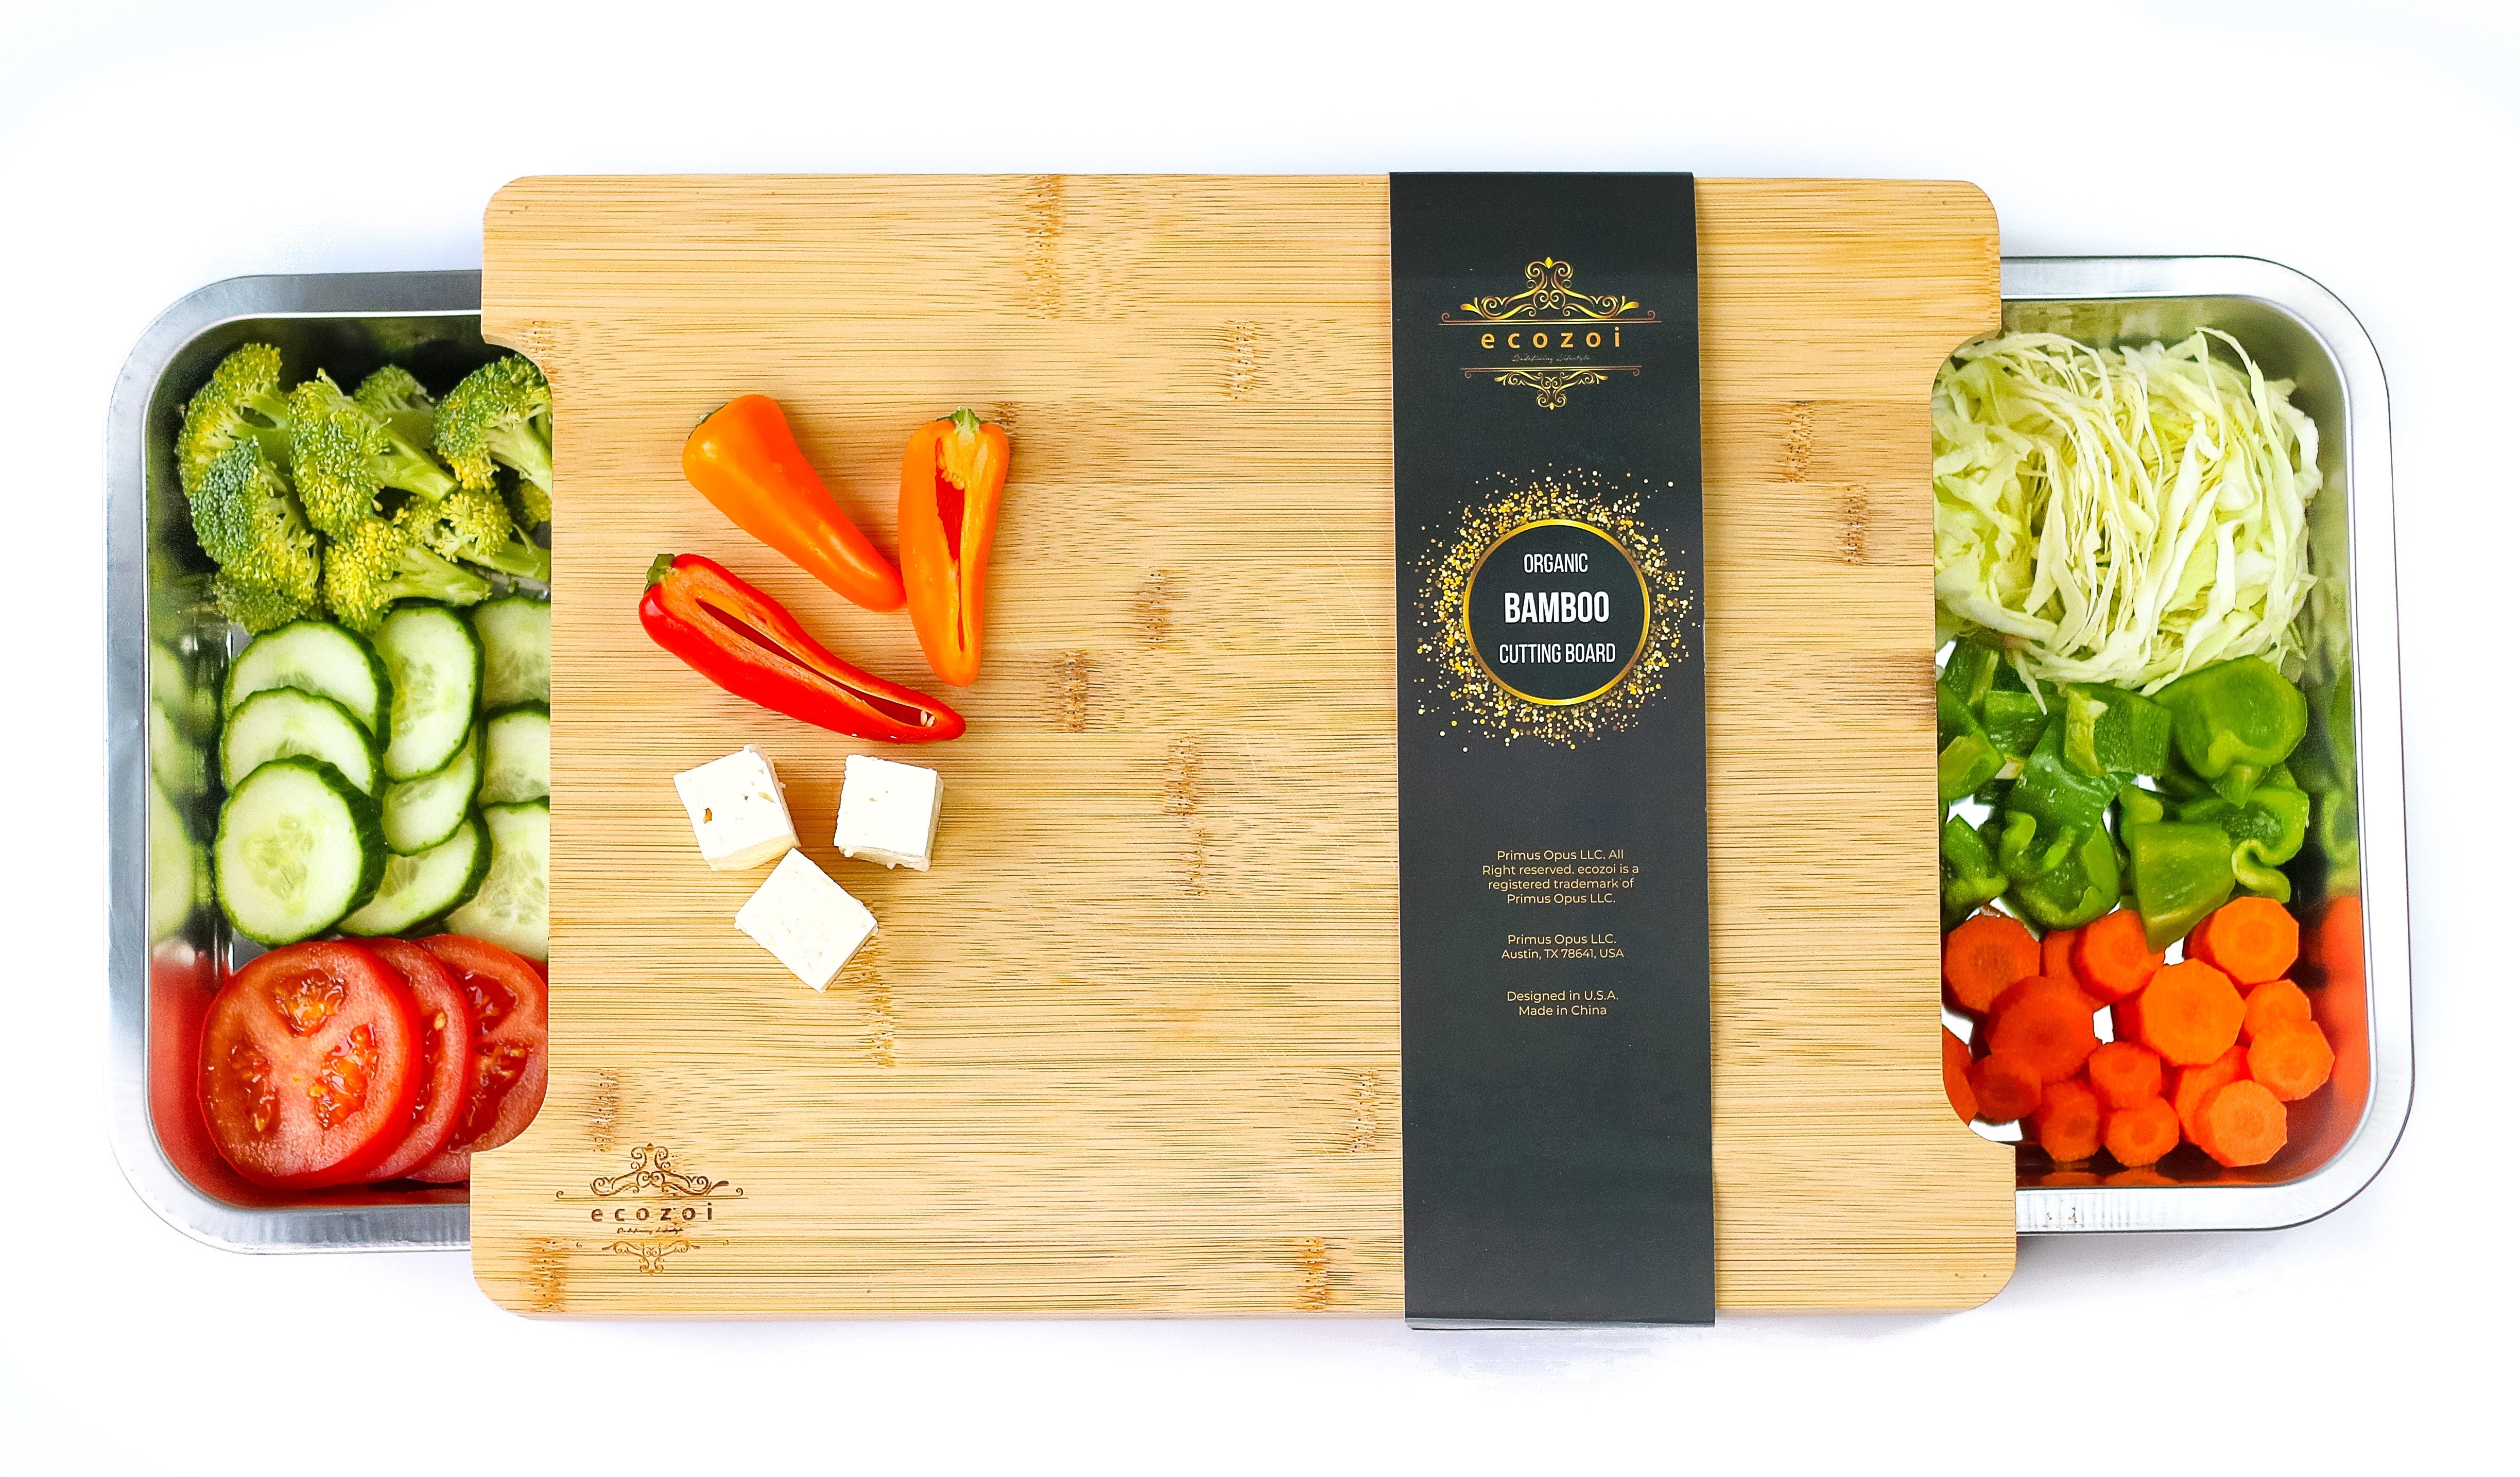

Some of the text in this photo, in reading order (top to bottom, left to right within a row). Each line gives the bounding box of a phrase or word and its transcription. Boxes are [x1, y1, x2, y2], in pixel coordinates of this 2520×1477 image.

[1481, 326, 1620, 349] ecozoi
[1524, 553, 1588, 573] ORGANIC
[1505, 591, 1609, 623] BAMBOO
[1499, 644, 1615, 664] CUTTING BOARD
[1497, 849, 1624, 862] Primus Opus LLC. All
[1482, 864, 1639, 877] Right reserved. ecozoi is a
[1489, 878, 1634, 892] registered trademark of
[1507, 893, 1615, 905] Primus Opus LLC.
[1508, 934, 1616, 946] Primus Opus LLC.
[1501, 948, 1624, 960] Austin, TX 78641, USA
[1507, 990, 1618, 1003] Designed in U.S.A.
[1519, 1005, 1607, 1016] Made in China
[591, 1202, 712, 1222] ecozoi
